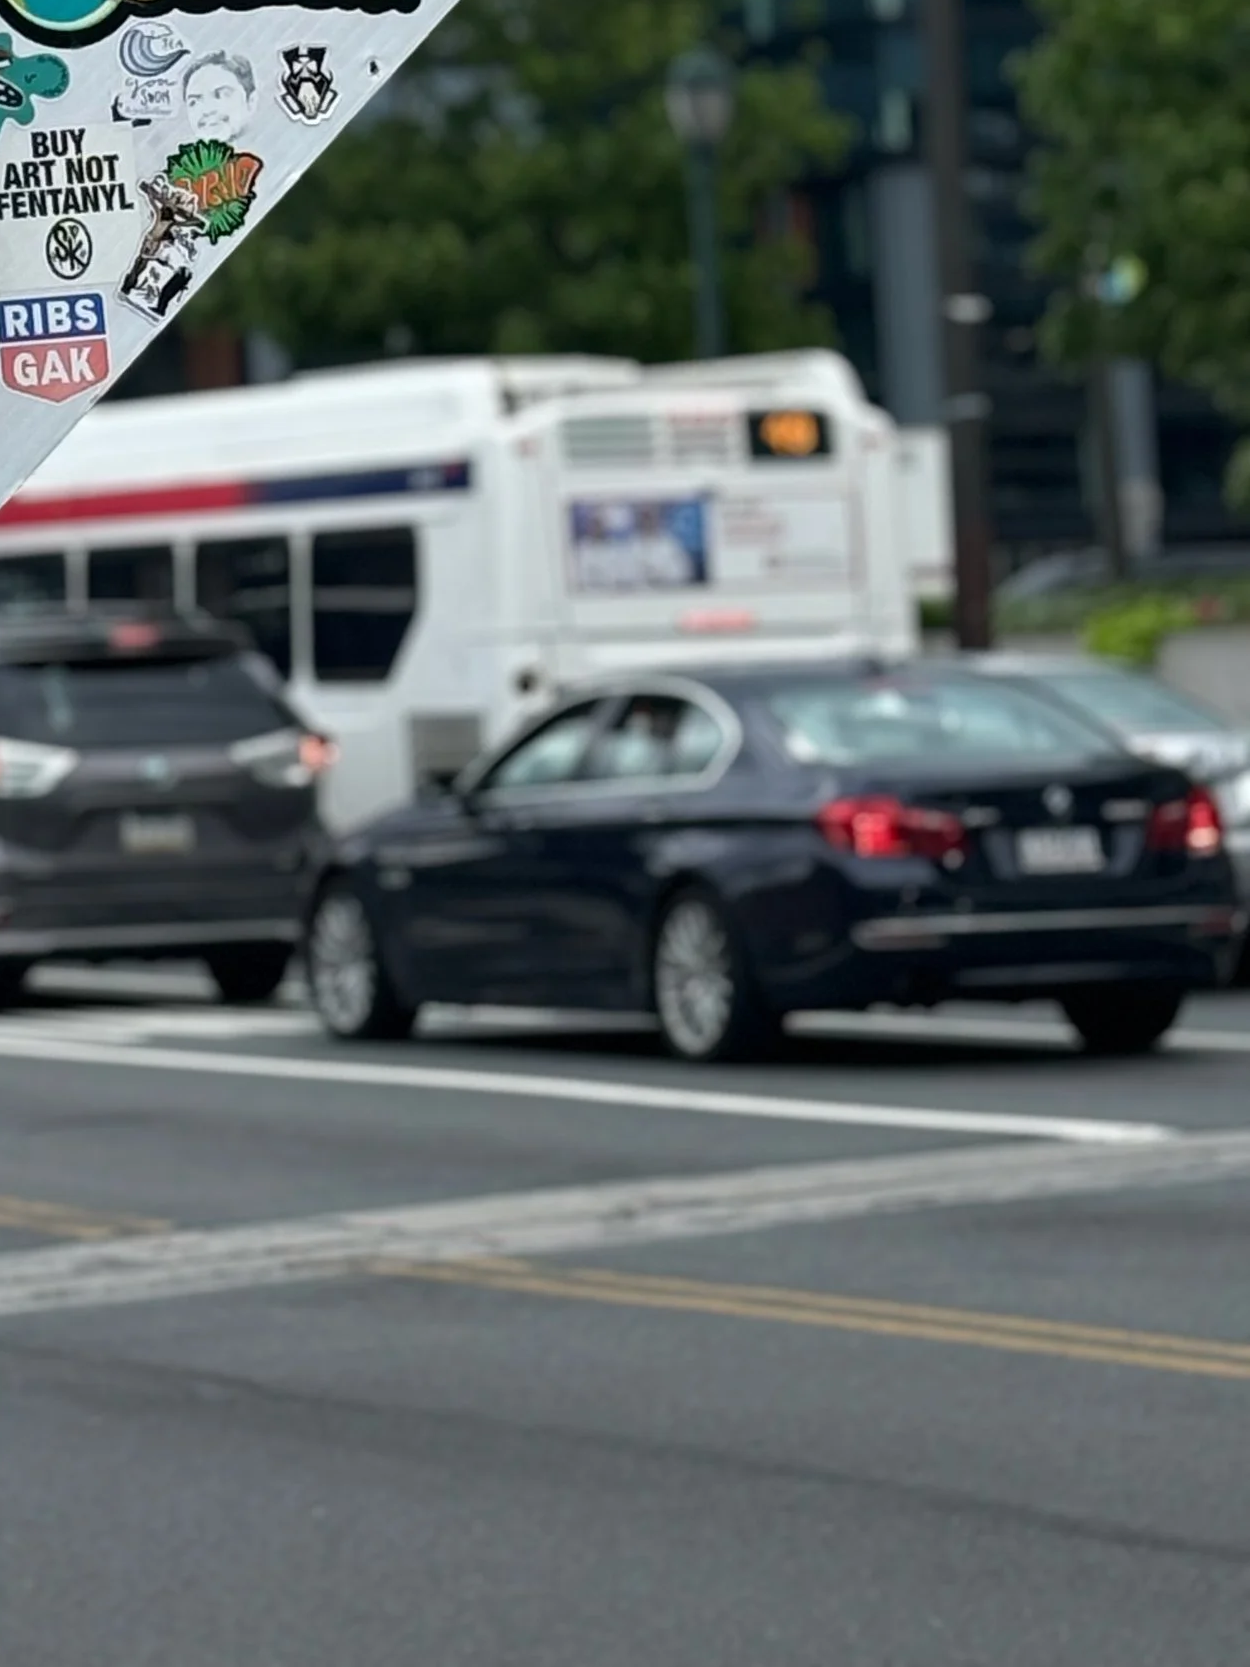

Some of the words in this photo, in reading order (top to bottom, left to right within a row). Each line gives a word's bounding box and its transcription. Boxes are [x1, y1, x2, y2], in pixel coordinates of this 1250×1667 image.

[31, 129, 87, 158] BUY
[4, 161, 55, 190] ART
[65, 156, 119, 184] NOT
[3, 299, 98, 337] RIBS
[13, 347, 94, 387] GAK
